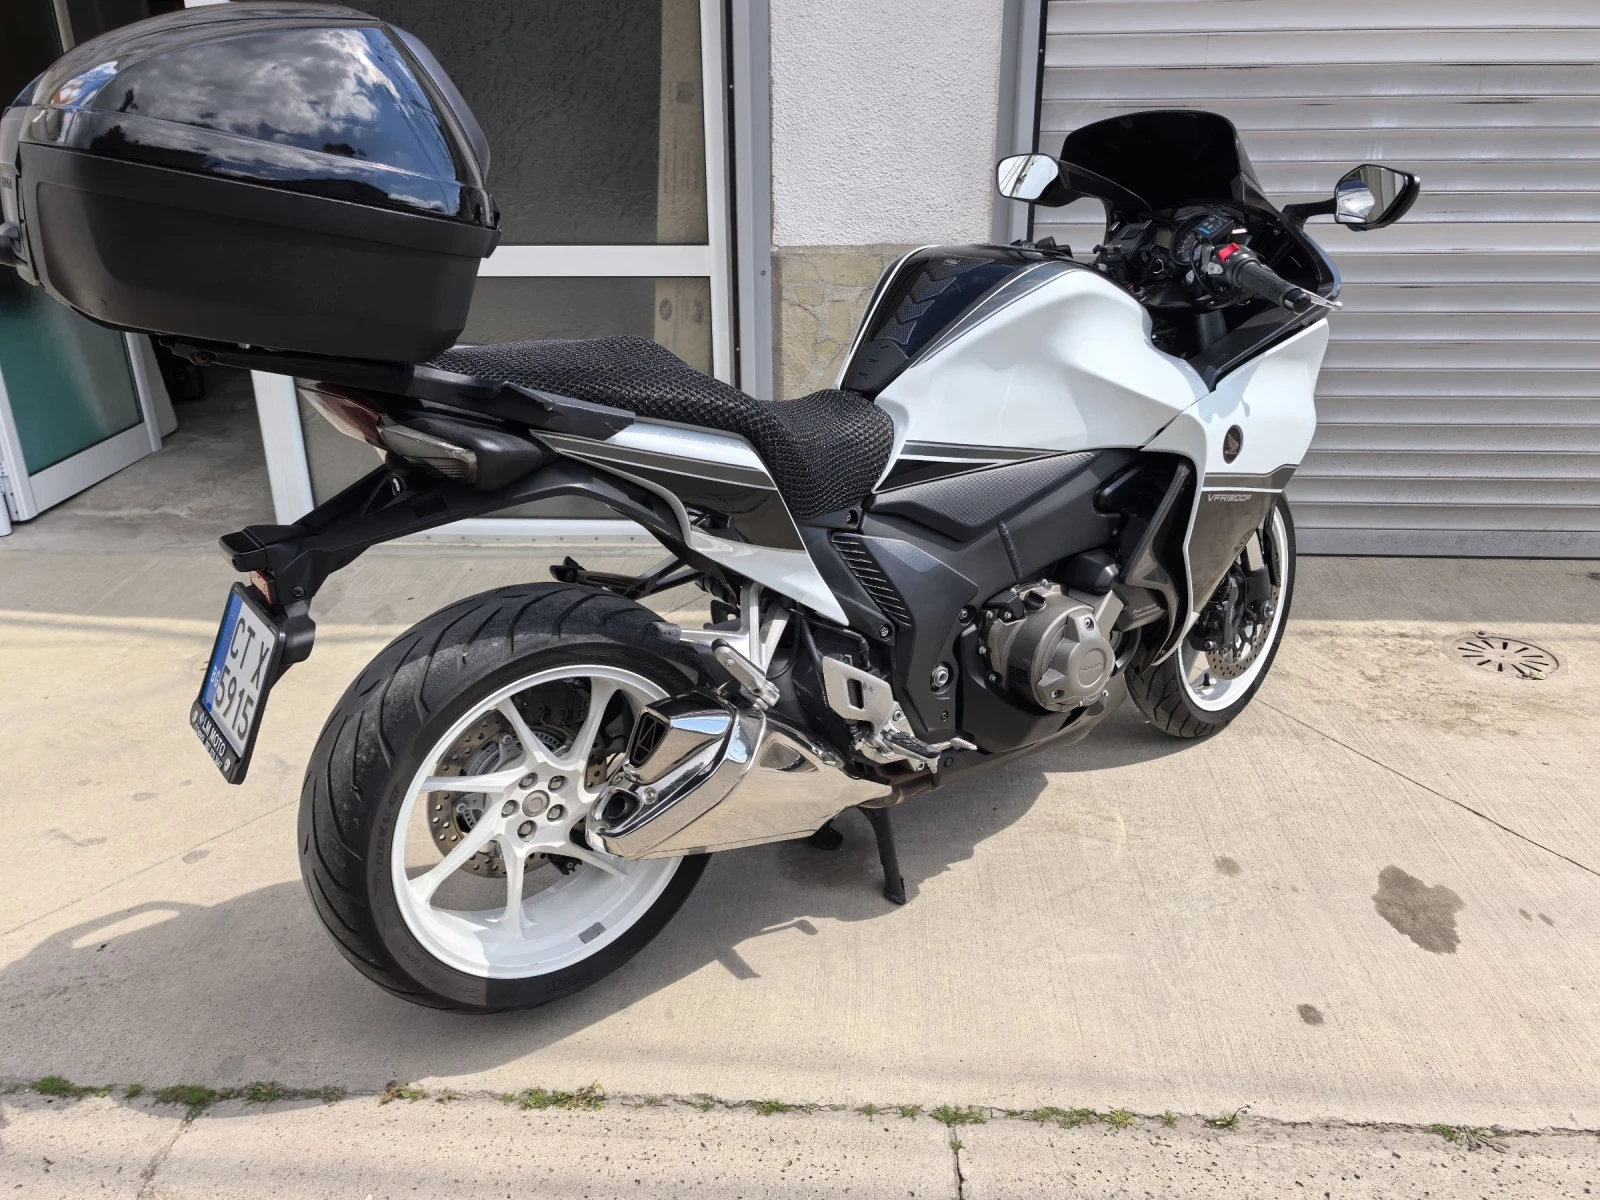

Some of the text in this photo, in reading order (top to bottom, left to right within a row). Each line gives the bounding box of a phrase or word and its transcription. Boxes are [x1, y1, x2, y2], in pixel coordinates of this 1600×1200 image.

[1207, 493, 1253, 502] VFR1200F
[230, 617, 270, 690] CT X
[210, 665, 220, 688] BG
[215, 666, 254, 742] 5915
[209, 727, 226, 757] MOTO
